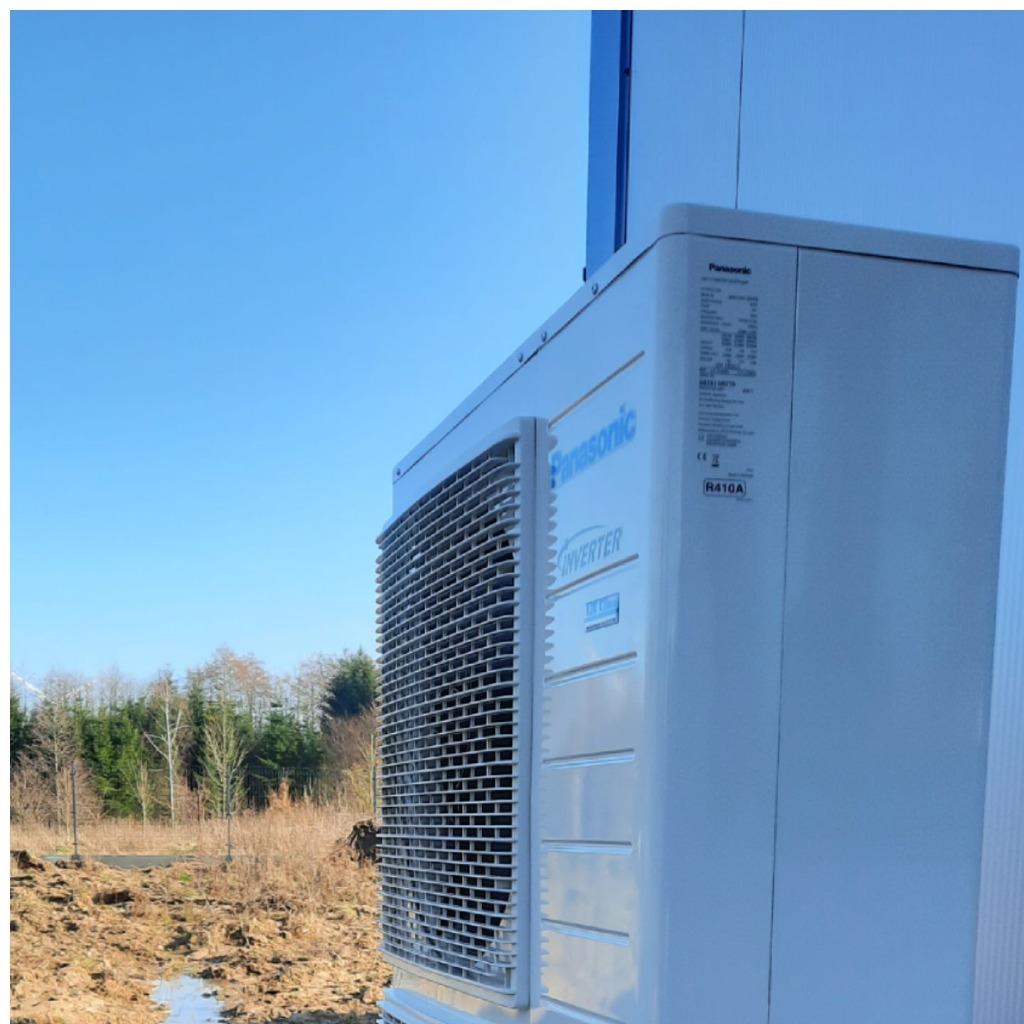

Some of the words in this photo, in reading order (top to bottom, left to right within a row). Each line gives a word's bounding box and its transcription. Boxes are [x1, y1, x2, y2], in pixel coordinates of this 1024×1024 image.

[708, 263, 752, 275] Panasonic
[550, 403, 638, 489] Panasonic
[705, 481, 744, 494] R410A
[561, 526, 623, 577] INVERTER
